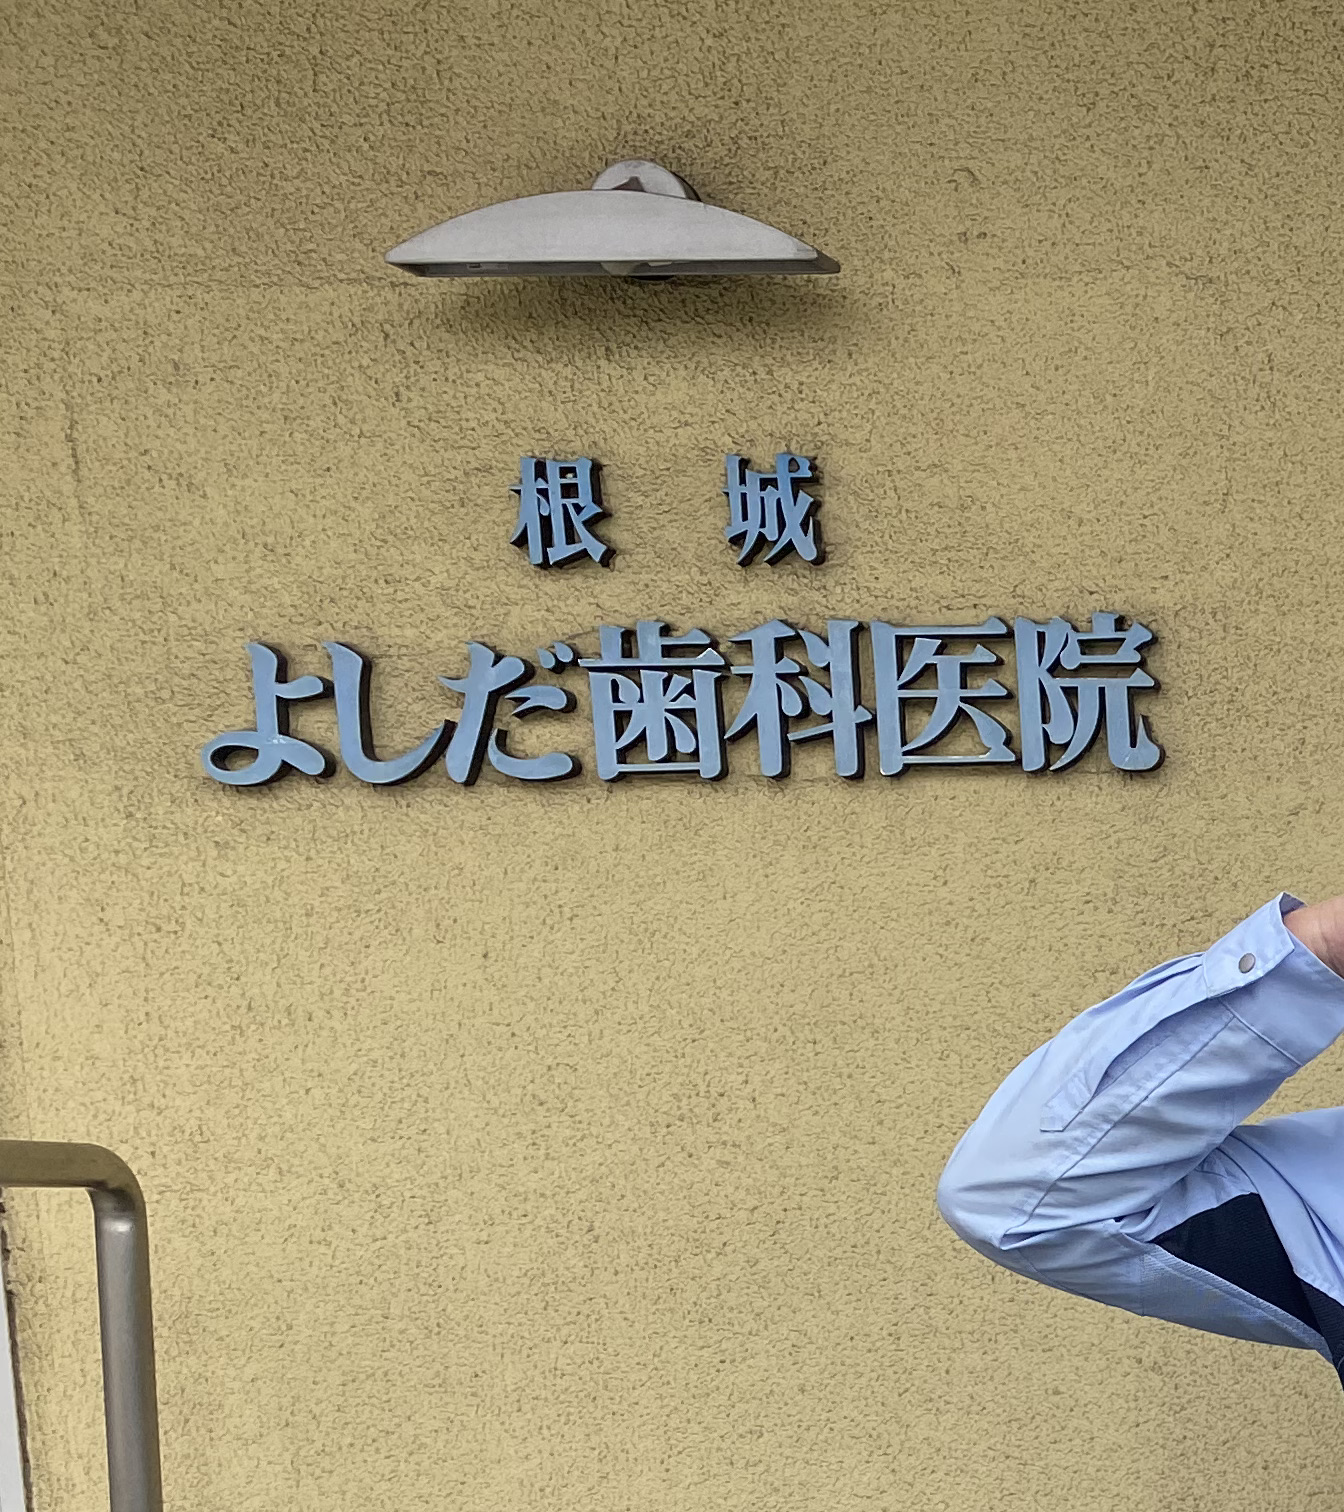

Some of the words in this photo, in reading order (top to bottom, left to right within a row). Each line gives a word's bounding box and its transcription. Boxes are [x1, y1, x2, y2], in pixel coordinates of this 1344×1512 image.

[202, 610, 1164, 786] よしだ歯科医院
